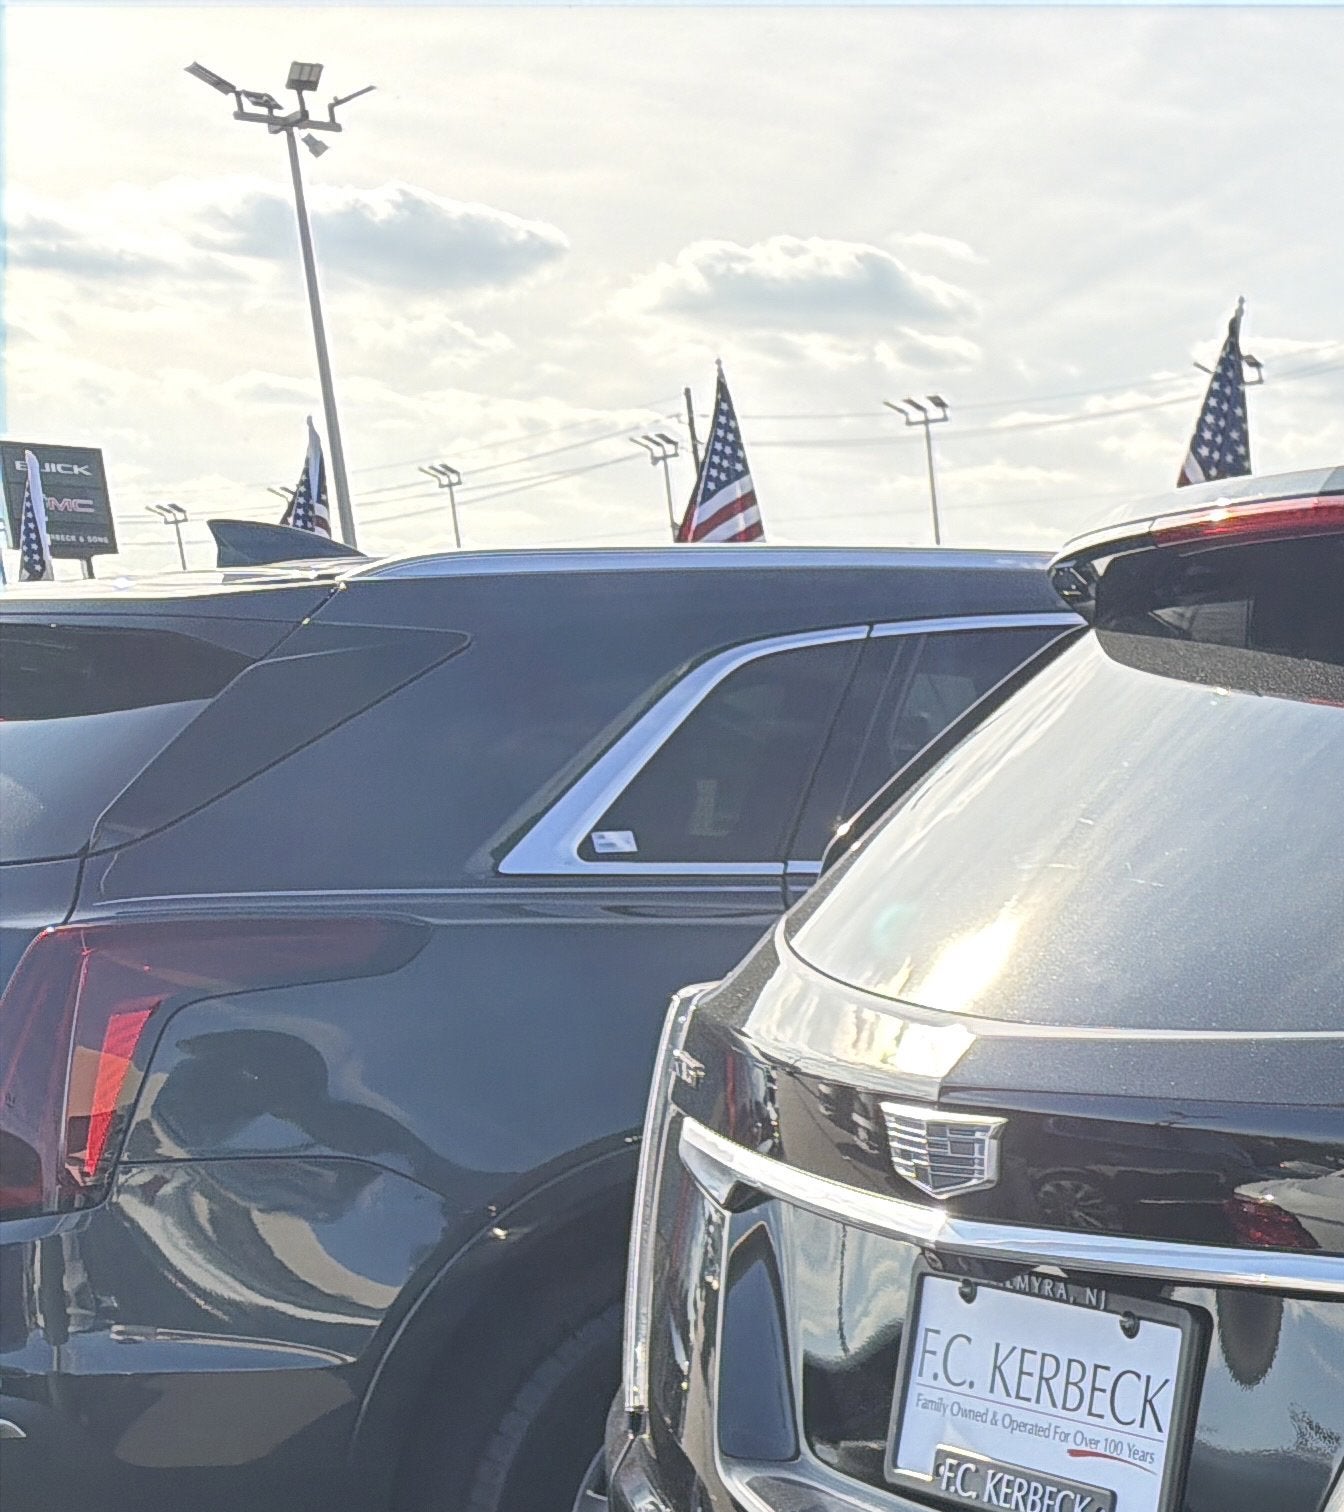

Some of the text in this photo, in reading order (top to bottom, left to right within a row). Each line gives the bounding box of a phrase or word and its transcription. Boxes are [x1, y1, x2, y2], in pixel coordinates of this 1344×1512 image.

[46, 497, 95, 513] MC
[1085, 1287, 1106, 1310] NJ
[917, 1327, 1170, 1433] F.C. KERBECK
[915, 1393, 1155, 1465] Family Owned & Operated For Over 100 Years
[940, 1458, 977, 1499] F.C.
